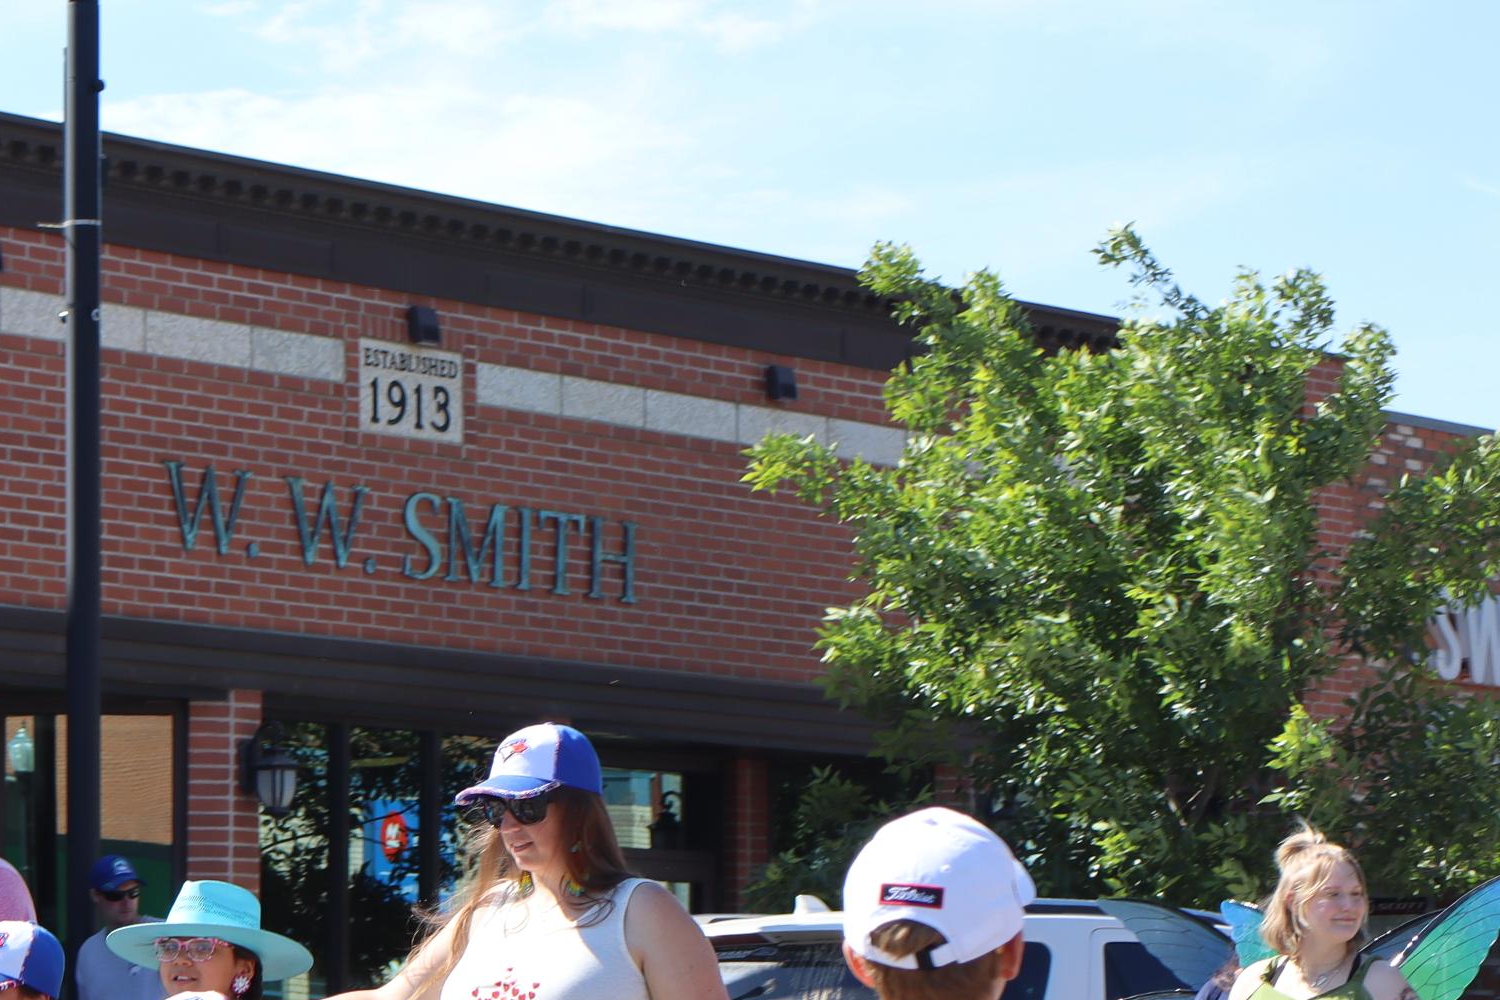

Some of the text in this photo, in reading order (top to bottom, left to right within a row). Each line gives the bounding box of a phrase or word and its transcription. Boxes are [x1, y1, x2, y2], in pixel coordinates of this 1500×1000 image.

[363, 347, 459, 379] ESTABLISHED
[369, 376, 451, 433] 1913
[163, 460, 640, 604] W. W. SMITH
